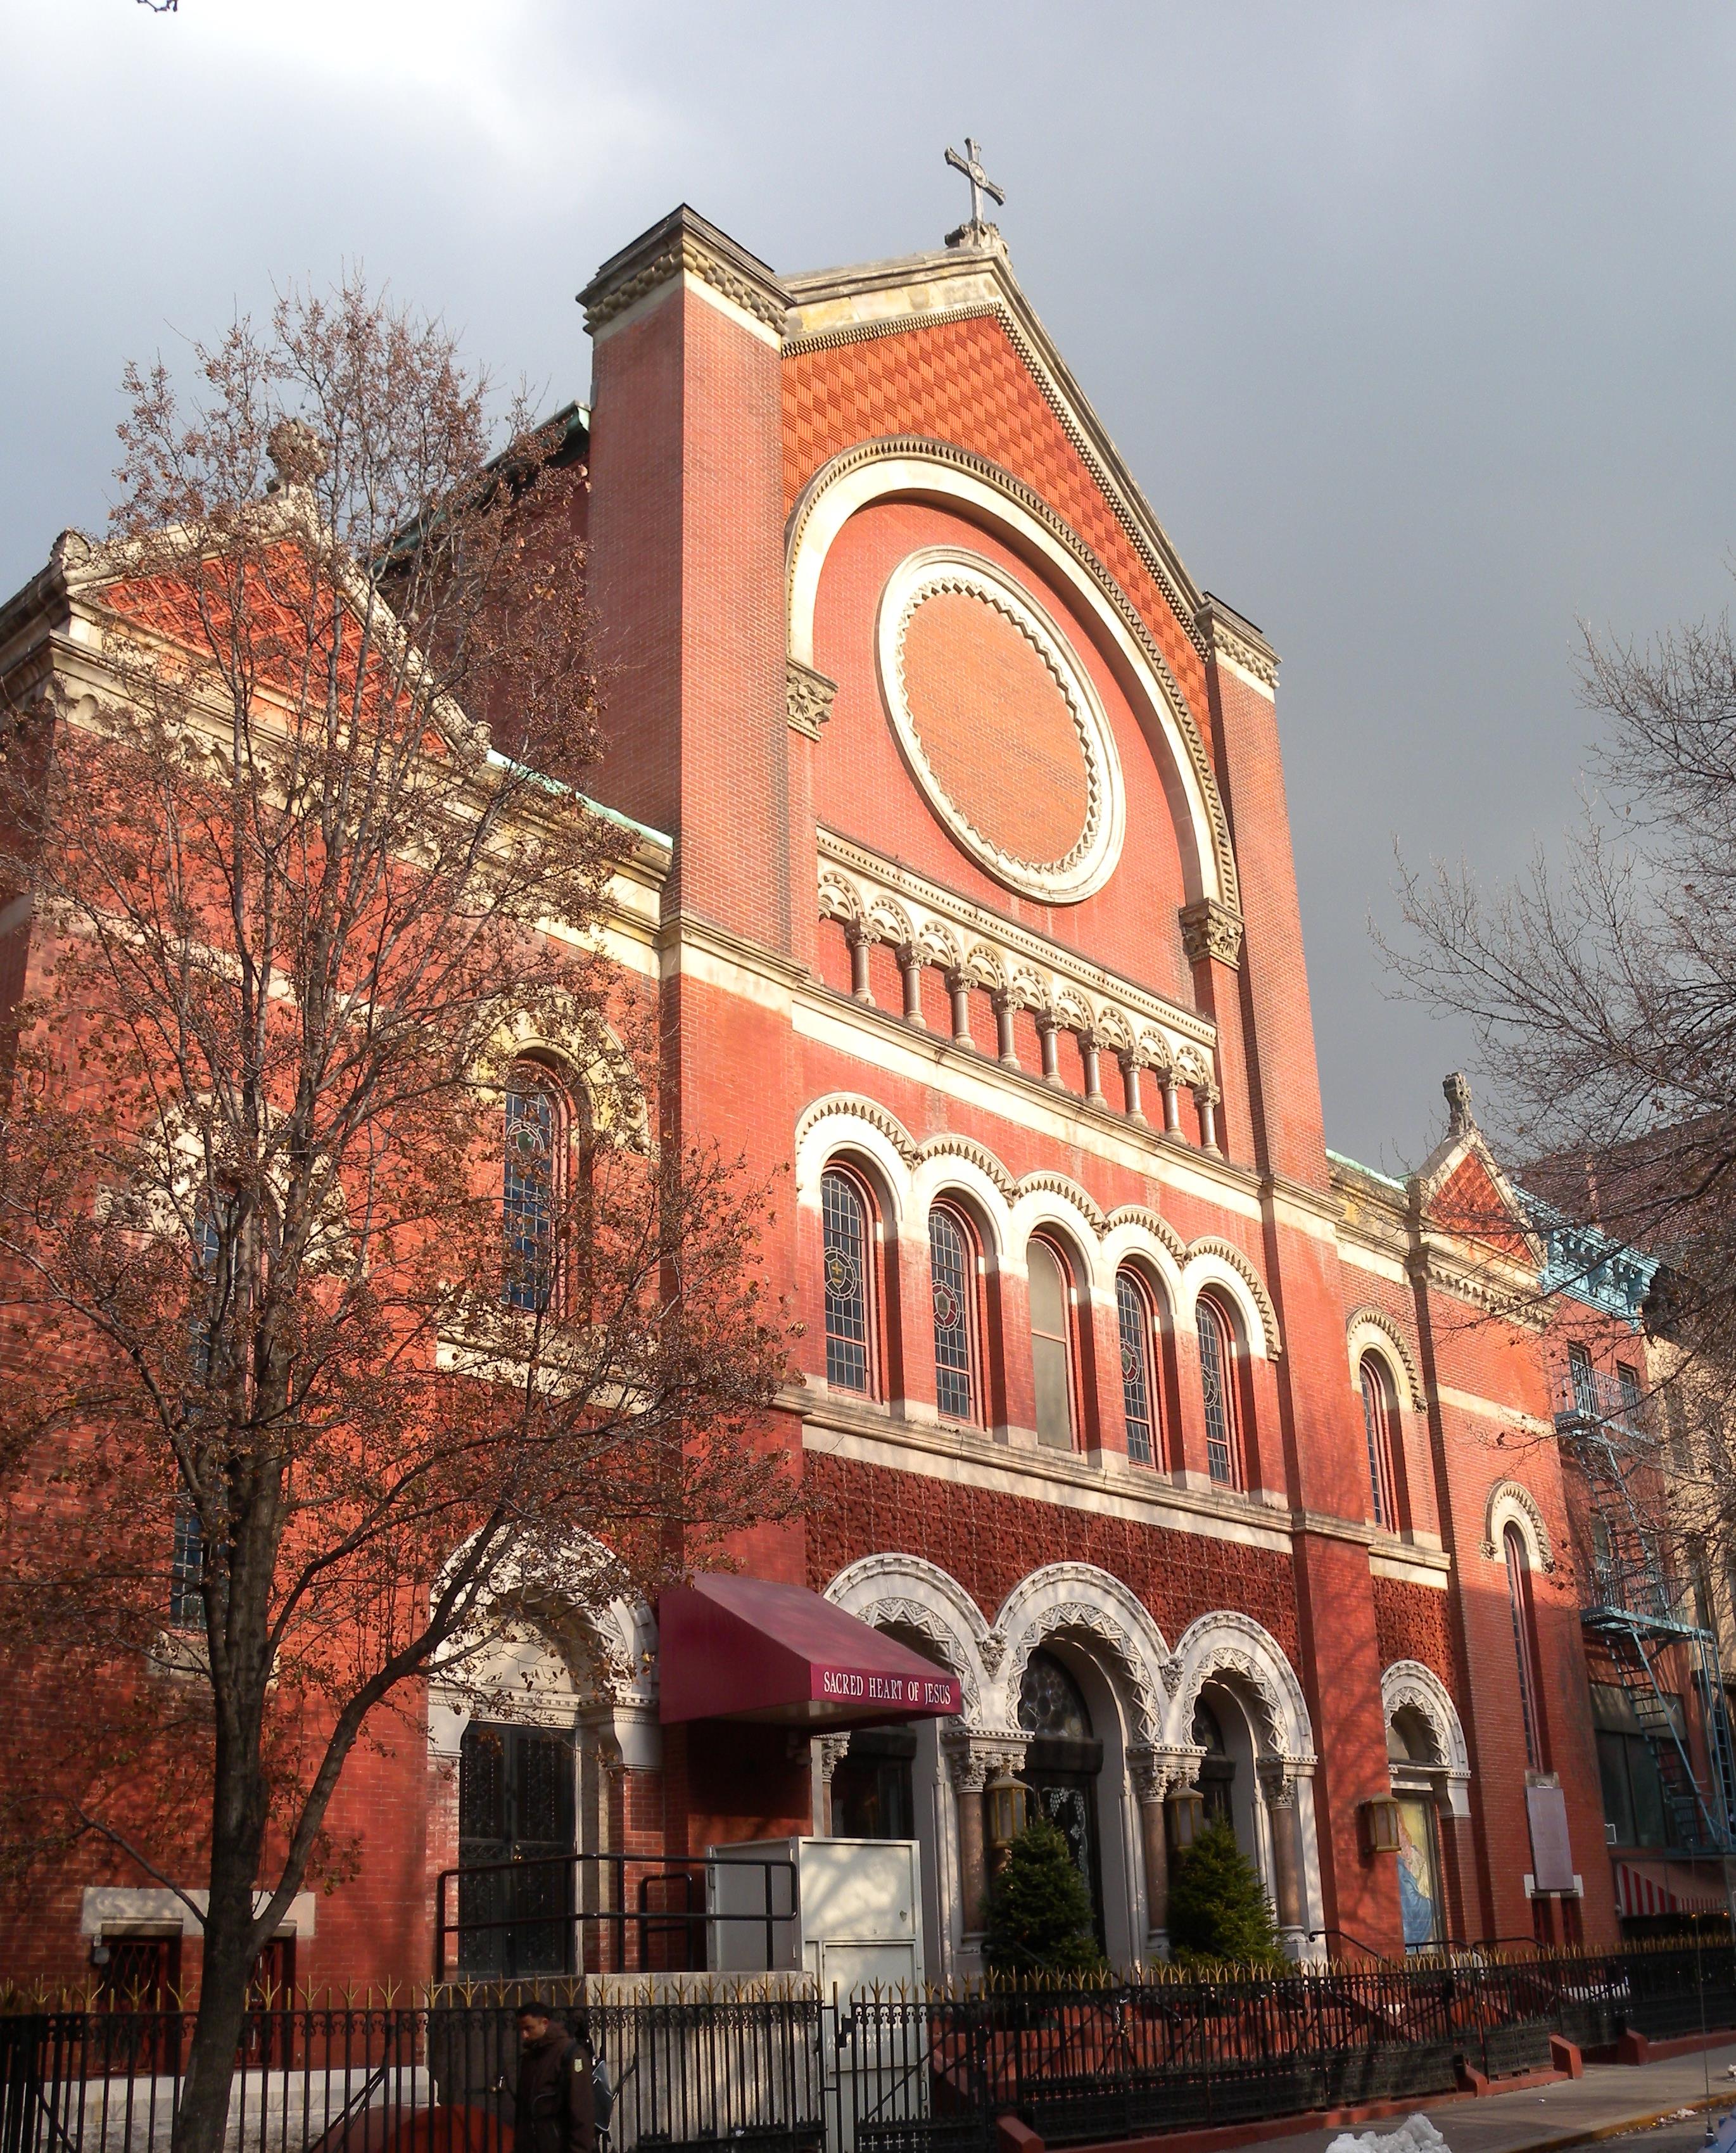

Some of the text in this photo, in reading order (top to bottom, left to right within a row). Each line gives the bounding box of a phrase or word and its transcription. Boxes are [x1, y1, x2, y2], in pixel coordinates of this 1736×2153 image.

[824, 1671, 951, 1705] SACRED HEART OF JESUS
